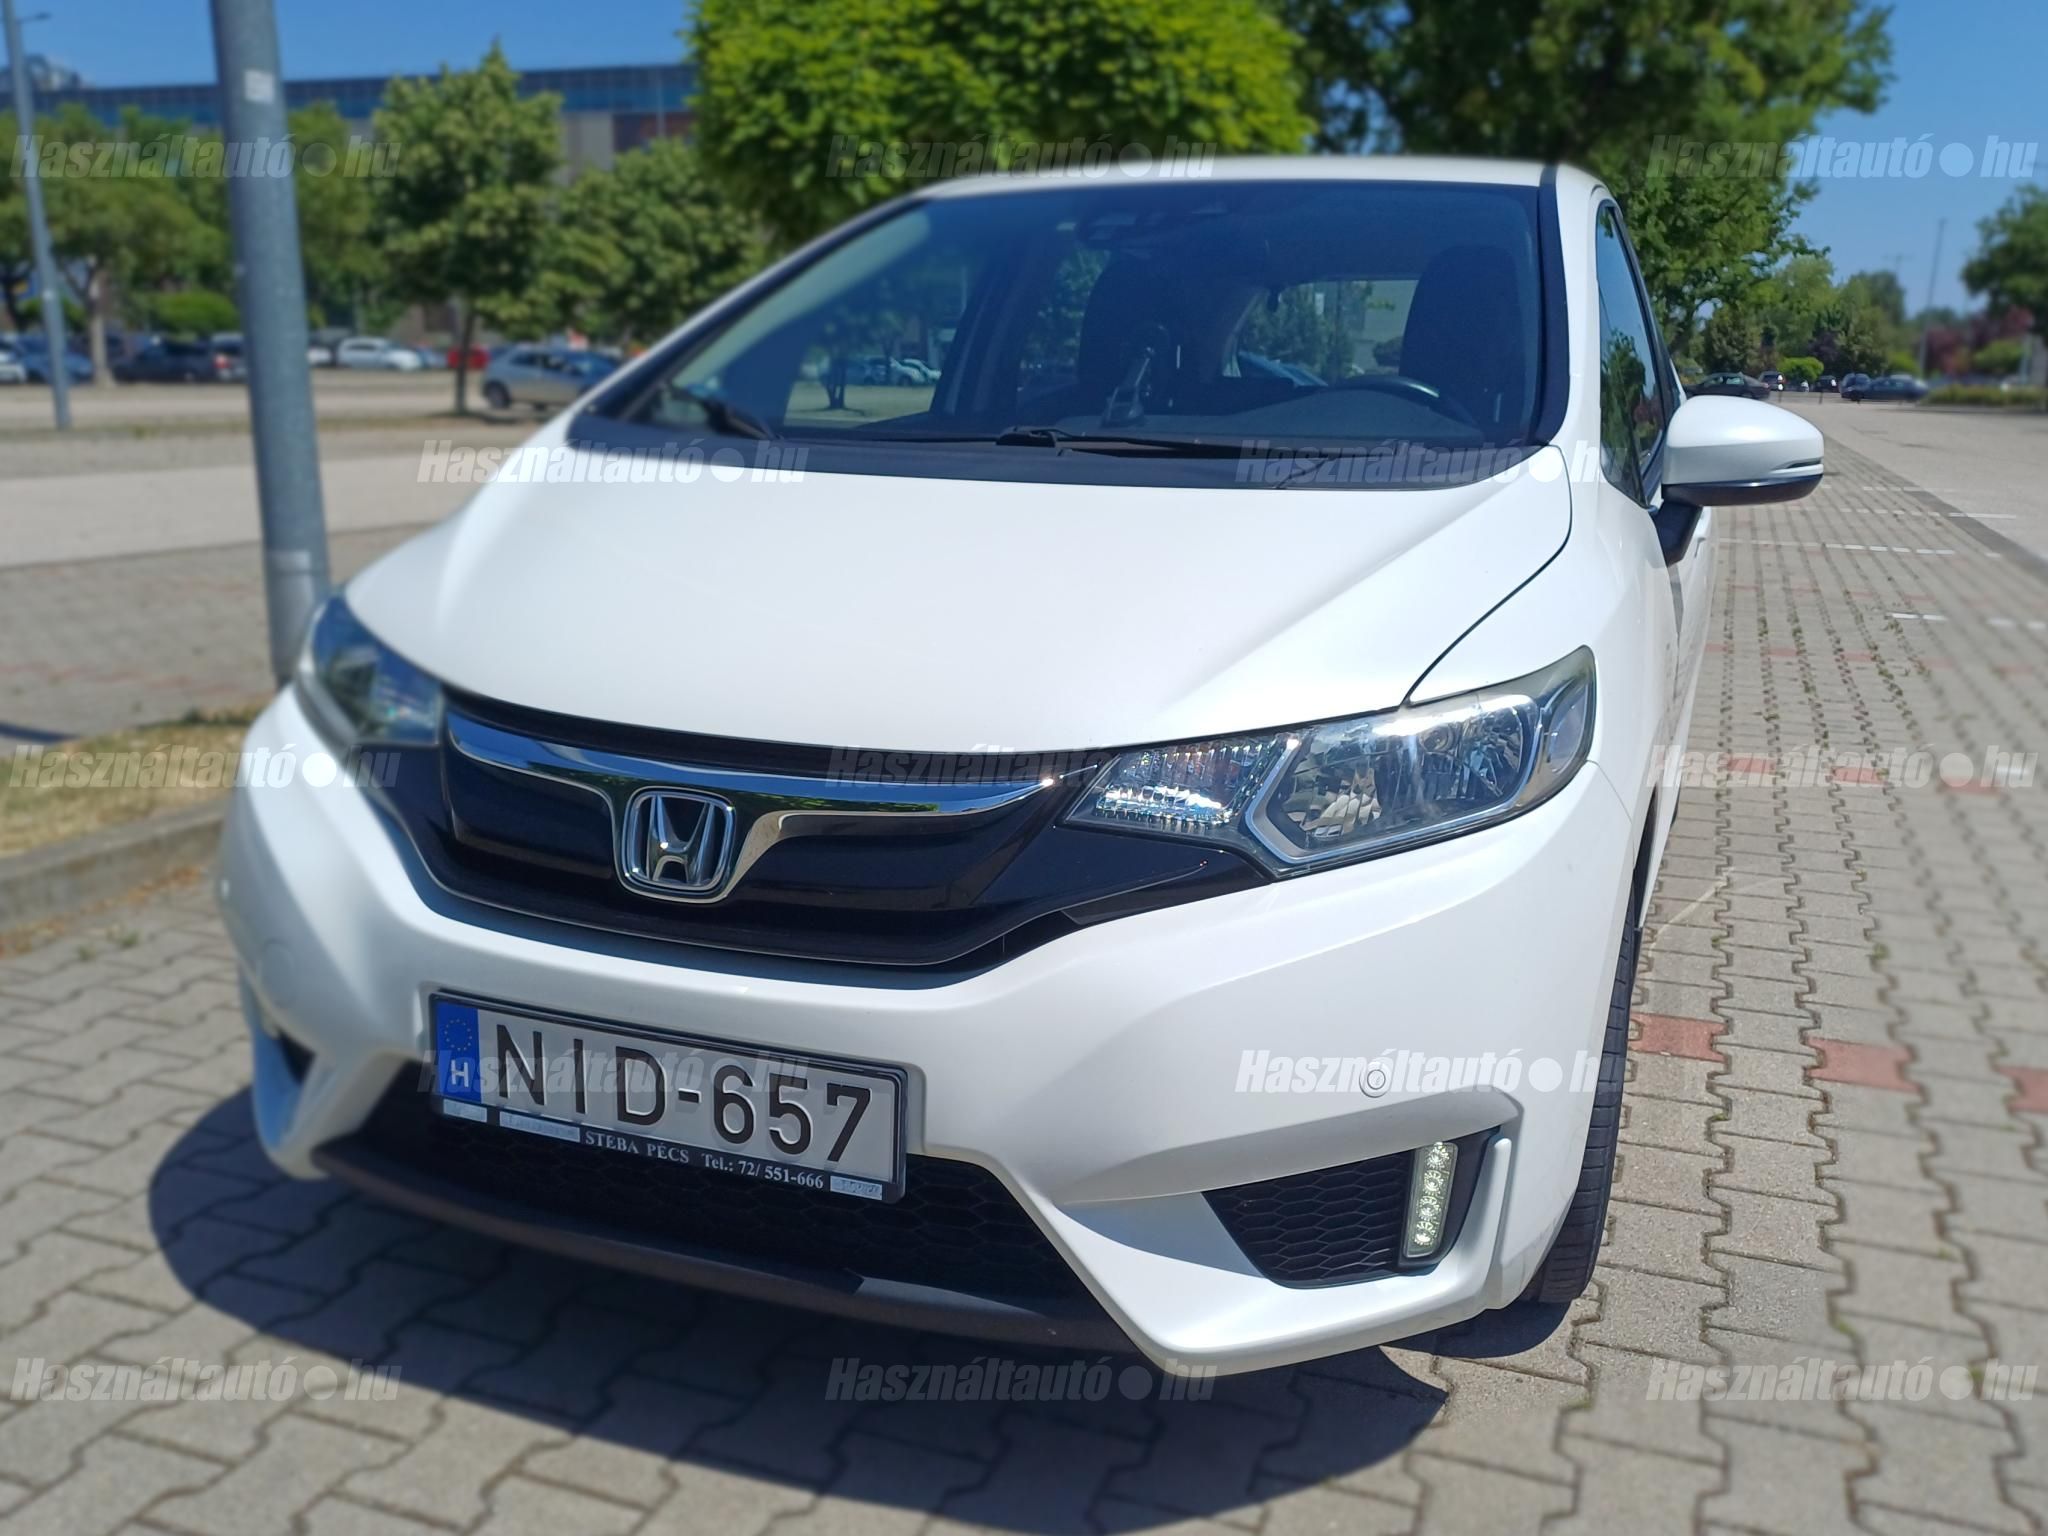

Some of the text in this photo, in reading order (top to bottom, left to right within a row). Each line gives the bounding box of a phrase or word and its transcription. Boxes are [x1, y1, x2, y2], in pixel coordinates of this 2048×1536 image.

[450, 1059, 469, 1088] H
[496, 1023, 873, 1163] NID-657
[585, 1130, 640, 1154] STEBA
[646, 1143, 690, 1164] PÉCS
[764, 1166, 824, 1189] 551-666
